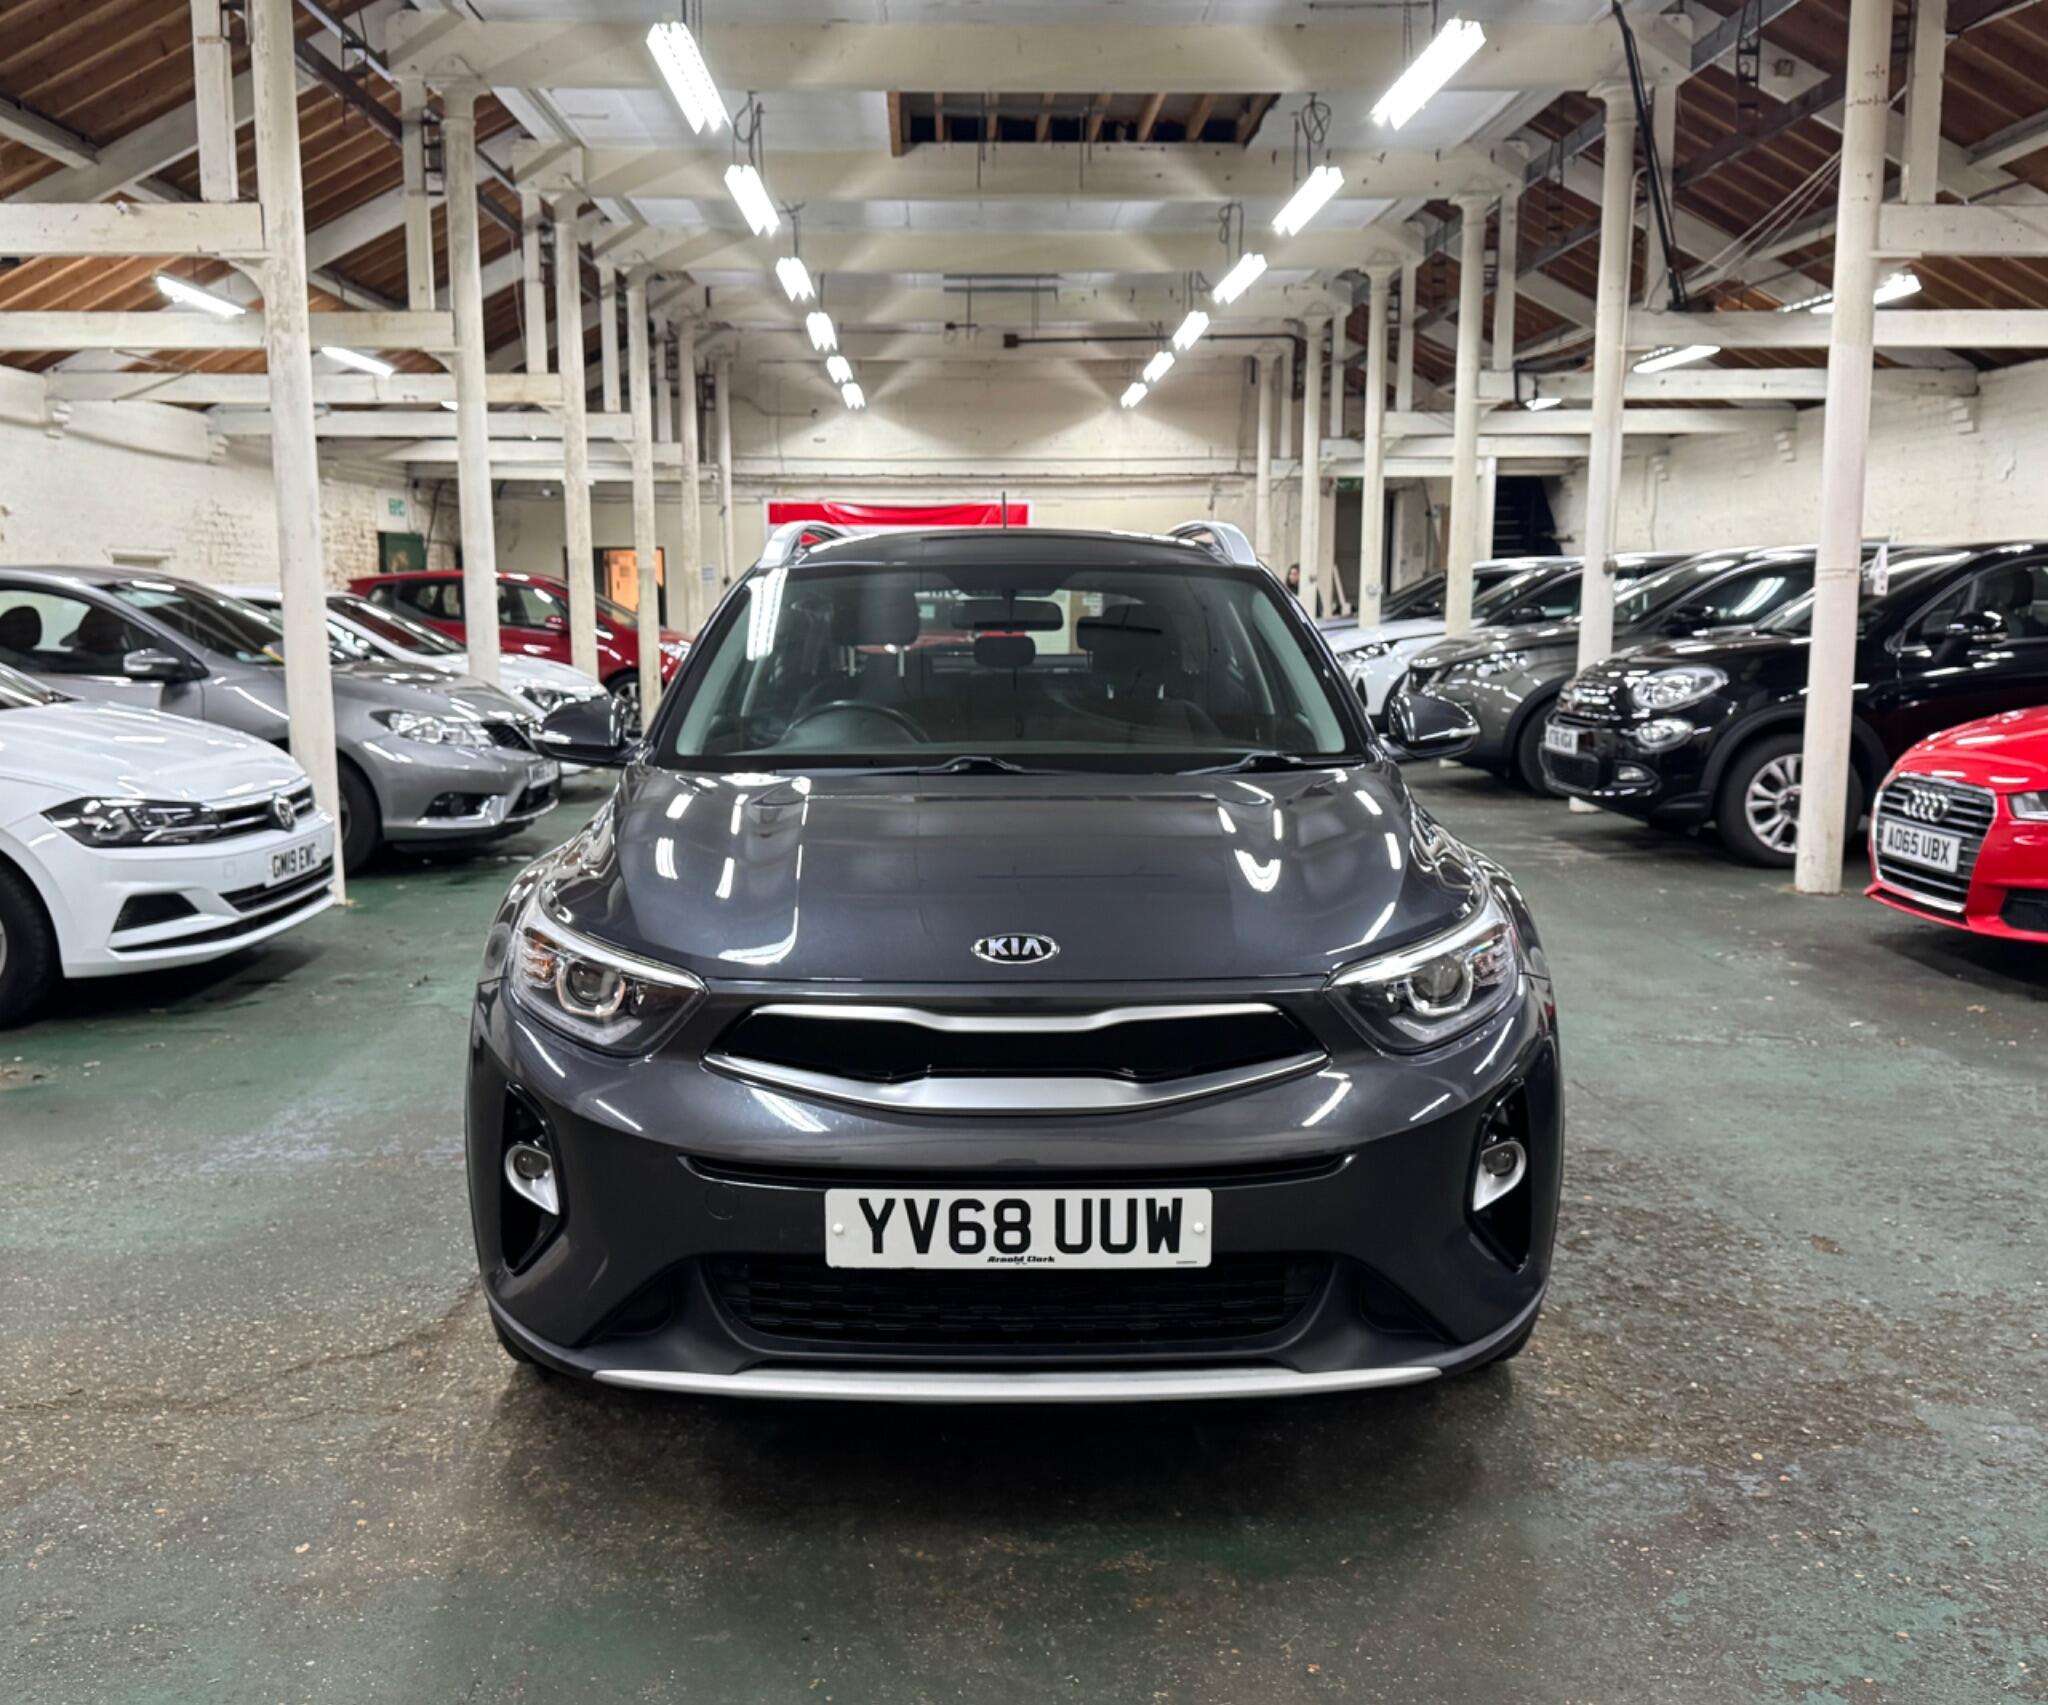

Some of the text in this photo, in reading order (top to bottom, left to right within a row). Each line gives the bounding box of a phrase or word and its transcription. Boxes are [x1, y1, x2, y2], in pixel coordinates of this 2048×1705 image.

[1921, 835, 1951, 864] UBX
[988, 937, 1044, 956] KIA
[858, 1197, 1183, 1254] YV68 UUW
[987, 1255, 1055, 1265] Arnold Clark
